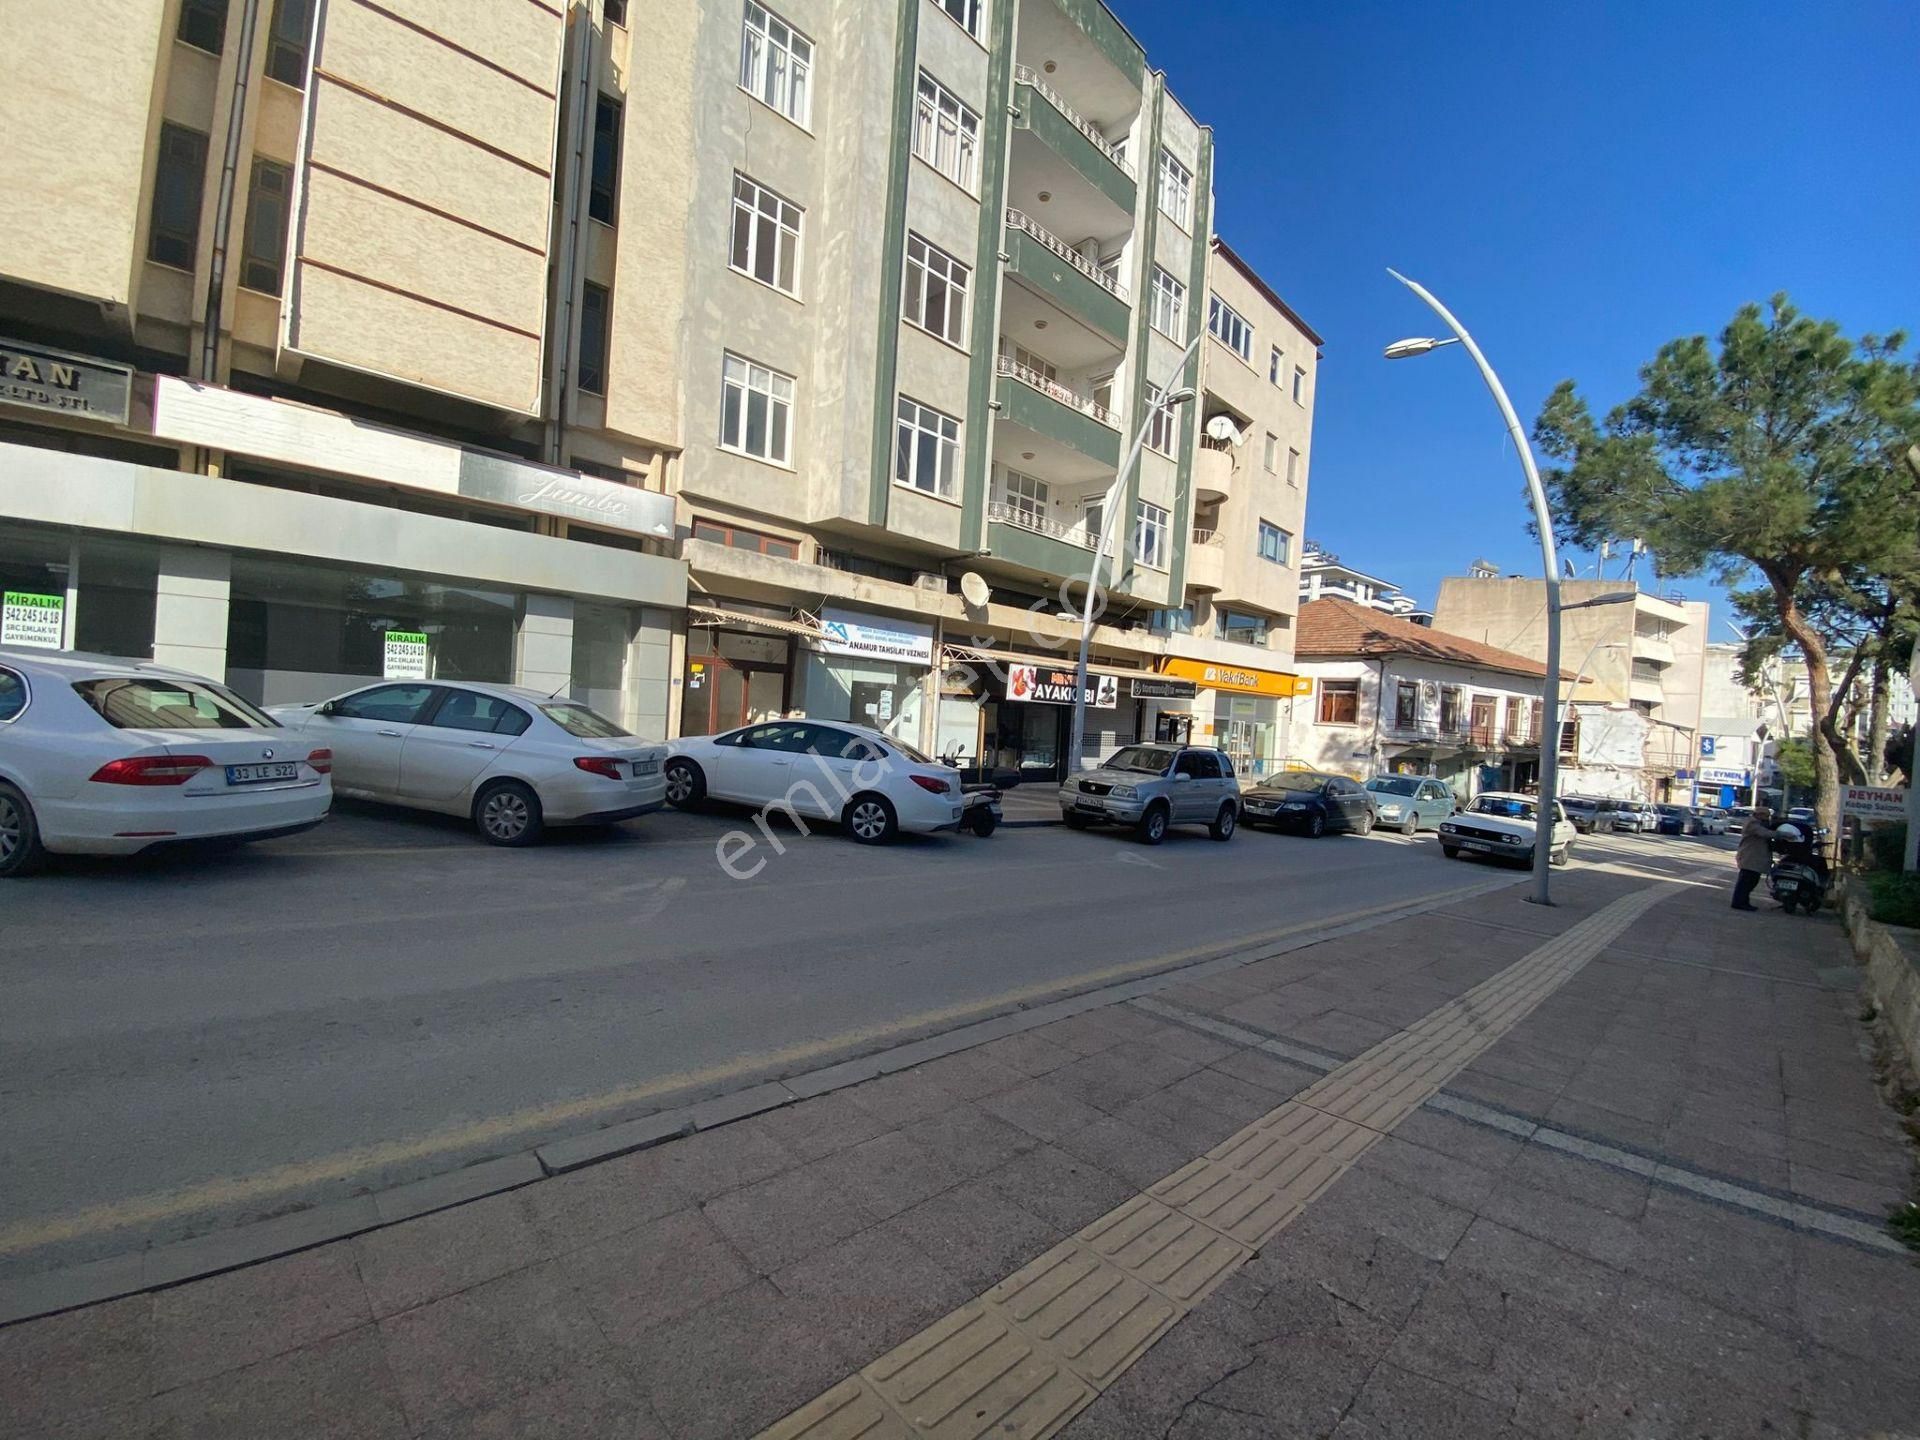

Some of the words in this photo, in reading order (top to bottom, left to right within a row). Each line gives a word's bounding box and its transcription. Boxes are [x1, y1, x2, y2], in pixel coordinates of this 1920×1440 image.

[0, 352, 77, 389] AN
[6, 594, 61, 609] KİRALIK
[6, 607, 21, 621] 542
[22, 608, 37, 622] 245
[39, 610, 48, 623] 14
[386, 633, 425, 643] KİRALIK
[849, 641, 878, 652] ANAMUR
[879, 645, 905, 656] TAHSİLAT
[906, 649, 929, 659] VEZNESİ
[1034, 683, 1095, 703] AYAKKBI
[235, 767, 250, 780] 33
[256, 766, 270, 778] LE
[275, 764, 295, 776] 522
[1848, 790, 1903, 803] REYHAN
